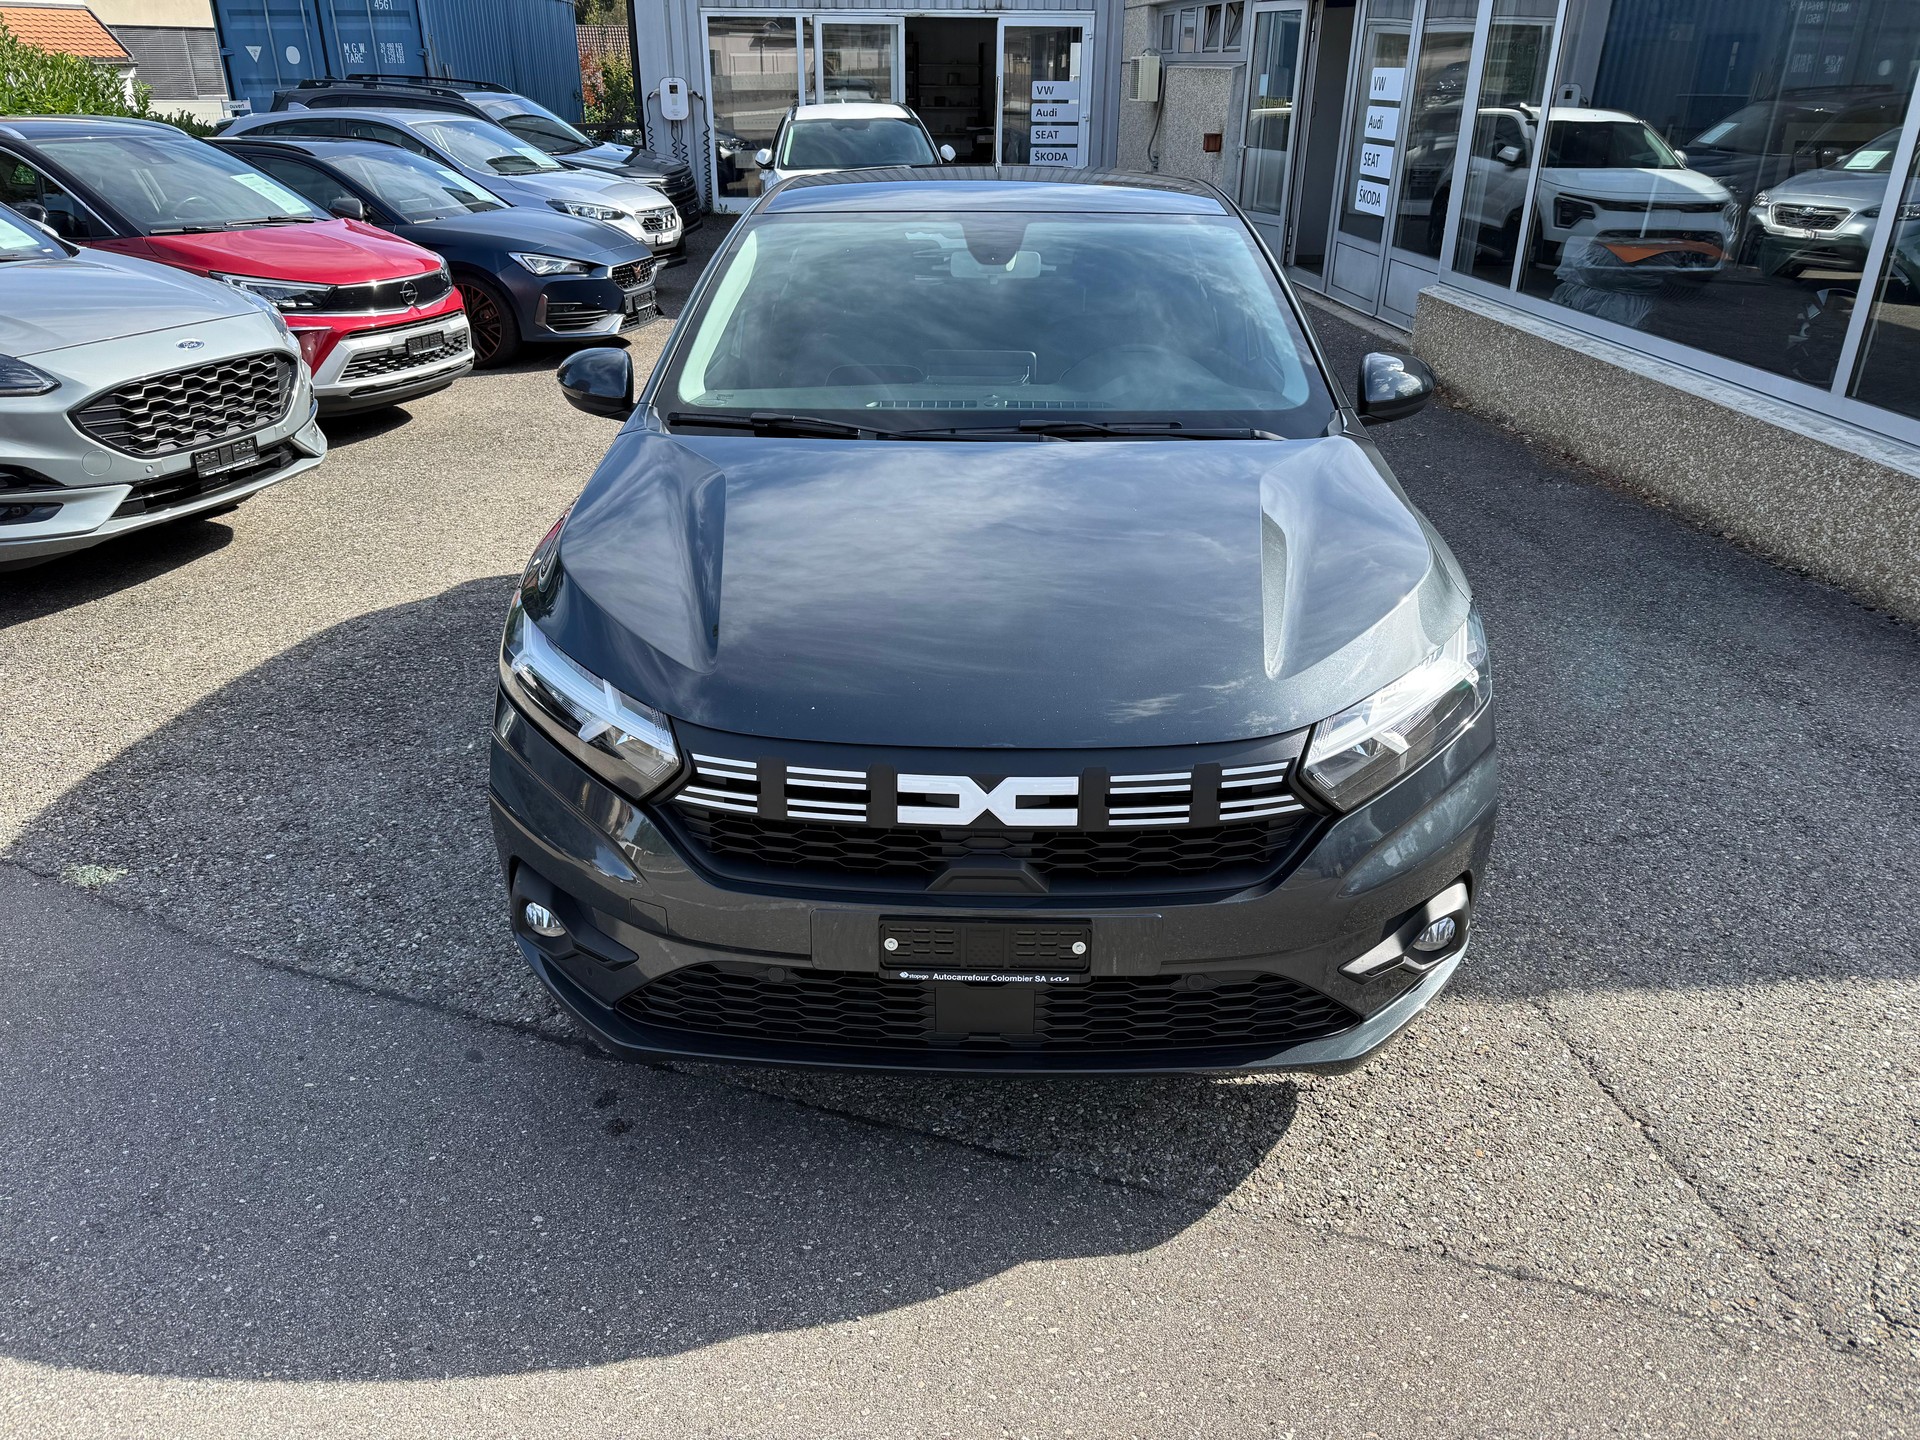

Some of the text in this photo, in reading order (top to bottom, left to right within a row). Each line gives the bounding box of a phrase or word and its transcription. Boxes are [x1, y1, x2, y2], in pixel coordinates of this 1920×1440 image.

[345, 53, 365, 64] TARE
[1373, 76, 1387, 92] VW
[1036, 86, 1054, 95] VW
[1035, 108, 1058, 117] Audi
[1367, 114, 1384, 130] Audi
[1035, 130, 1059, 139] SEAT
[1034, 150, 1068, 162] ŠKODA
[1363, 151, 1381, 168] SEAT
[1358, 185, 1381, 207] ŠKODA
[933, 973, 989, 982] Autocarrefour
[991, 974, 1033, 983] Colombier
[1034, 975, 1047, 983] SA
